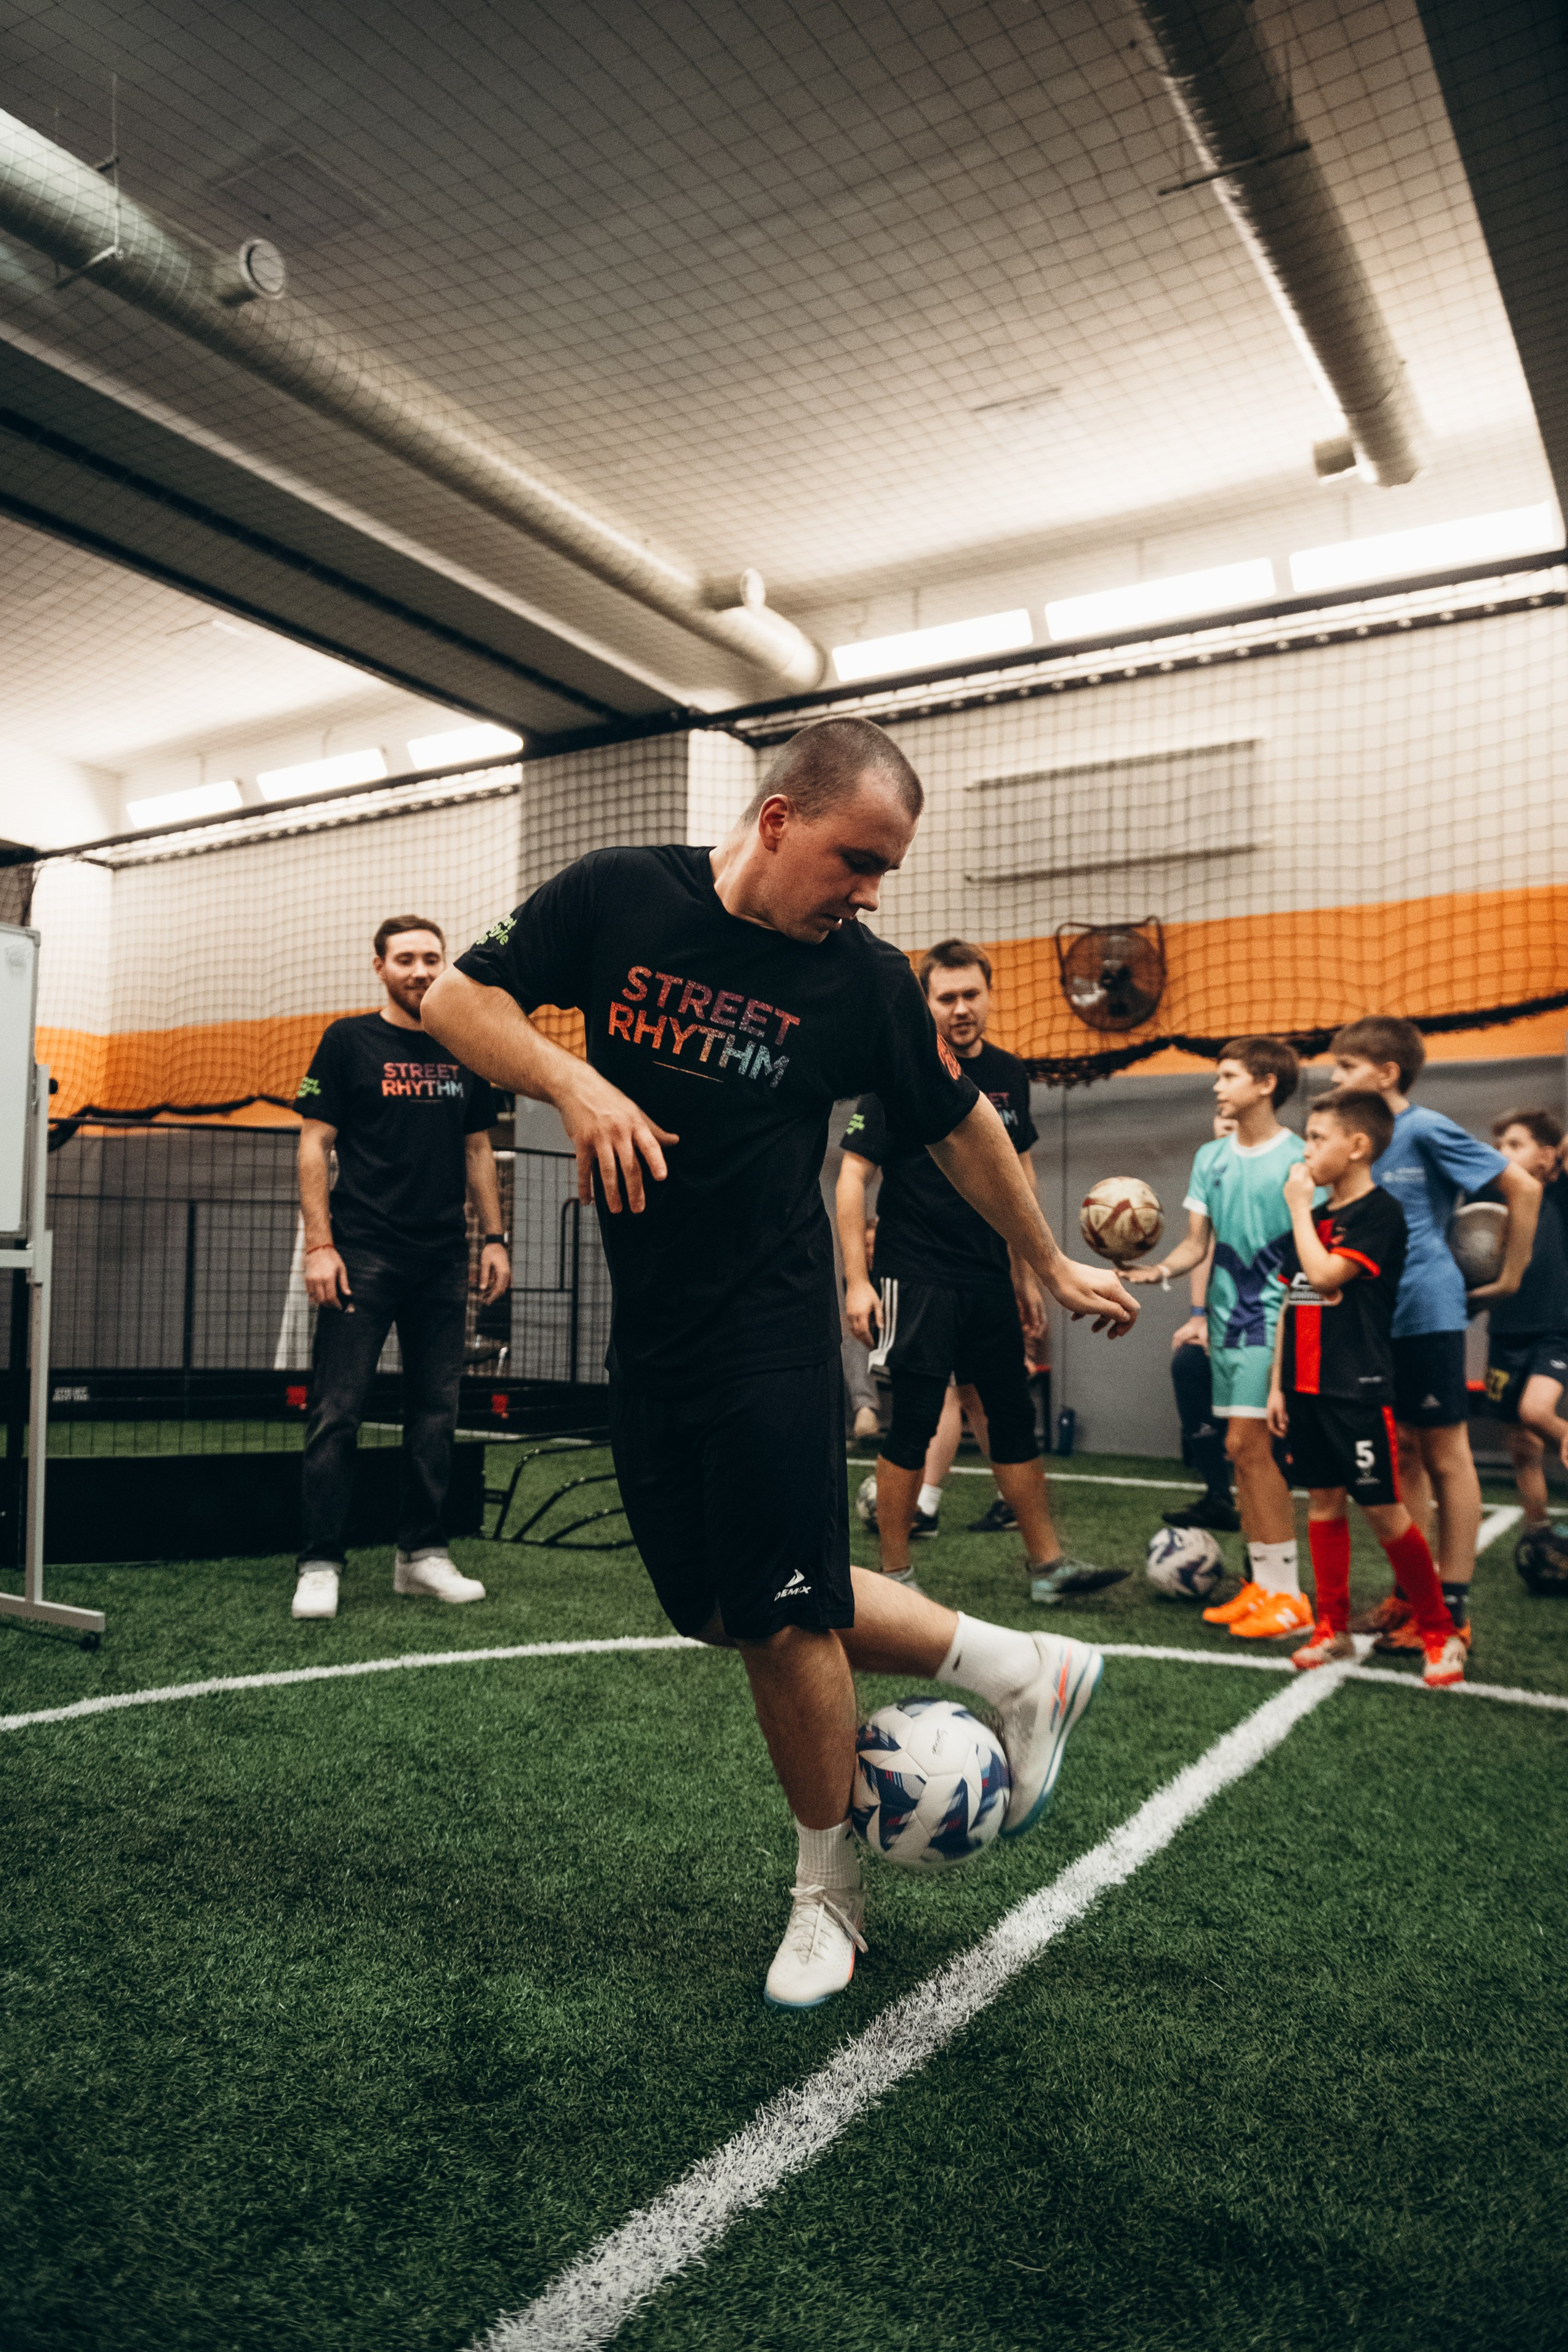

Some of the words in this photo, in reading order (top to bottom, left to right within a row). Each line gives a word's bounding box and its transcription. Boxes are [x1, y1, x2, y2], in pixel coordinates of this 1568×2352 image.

[622, 966, 801, 1046] STREET
[608, 1001, 790, 1088] RHYTHM
[383, 1062, 459, 1080] STREET
[382, 1079, 464, 1098] RHYTHM
[1355, 1439, 1376, 1468] 5
[774, 1586, 812, 1601] DEMIX
